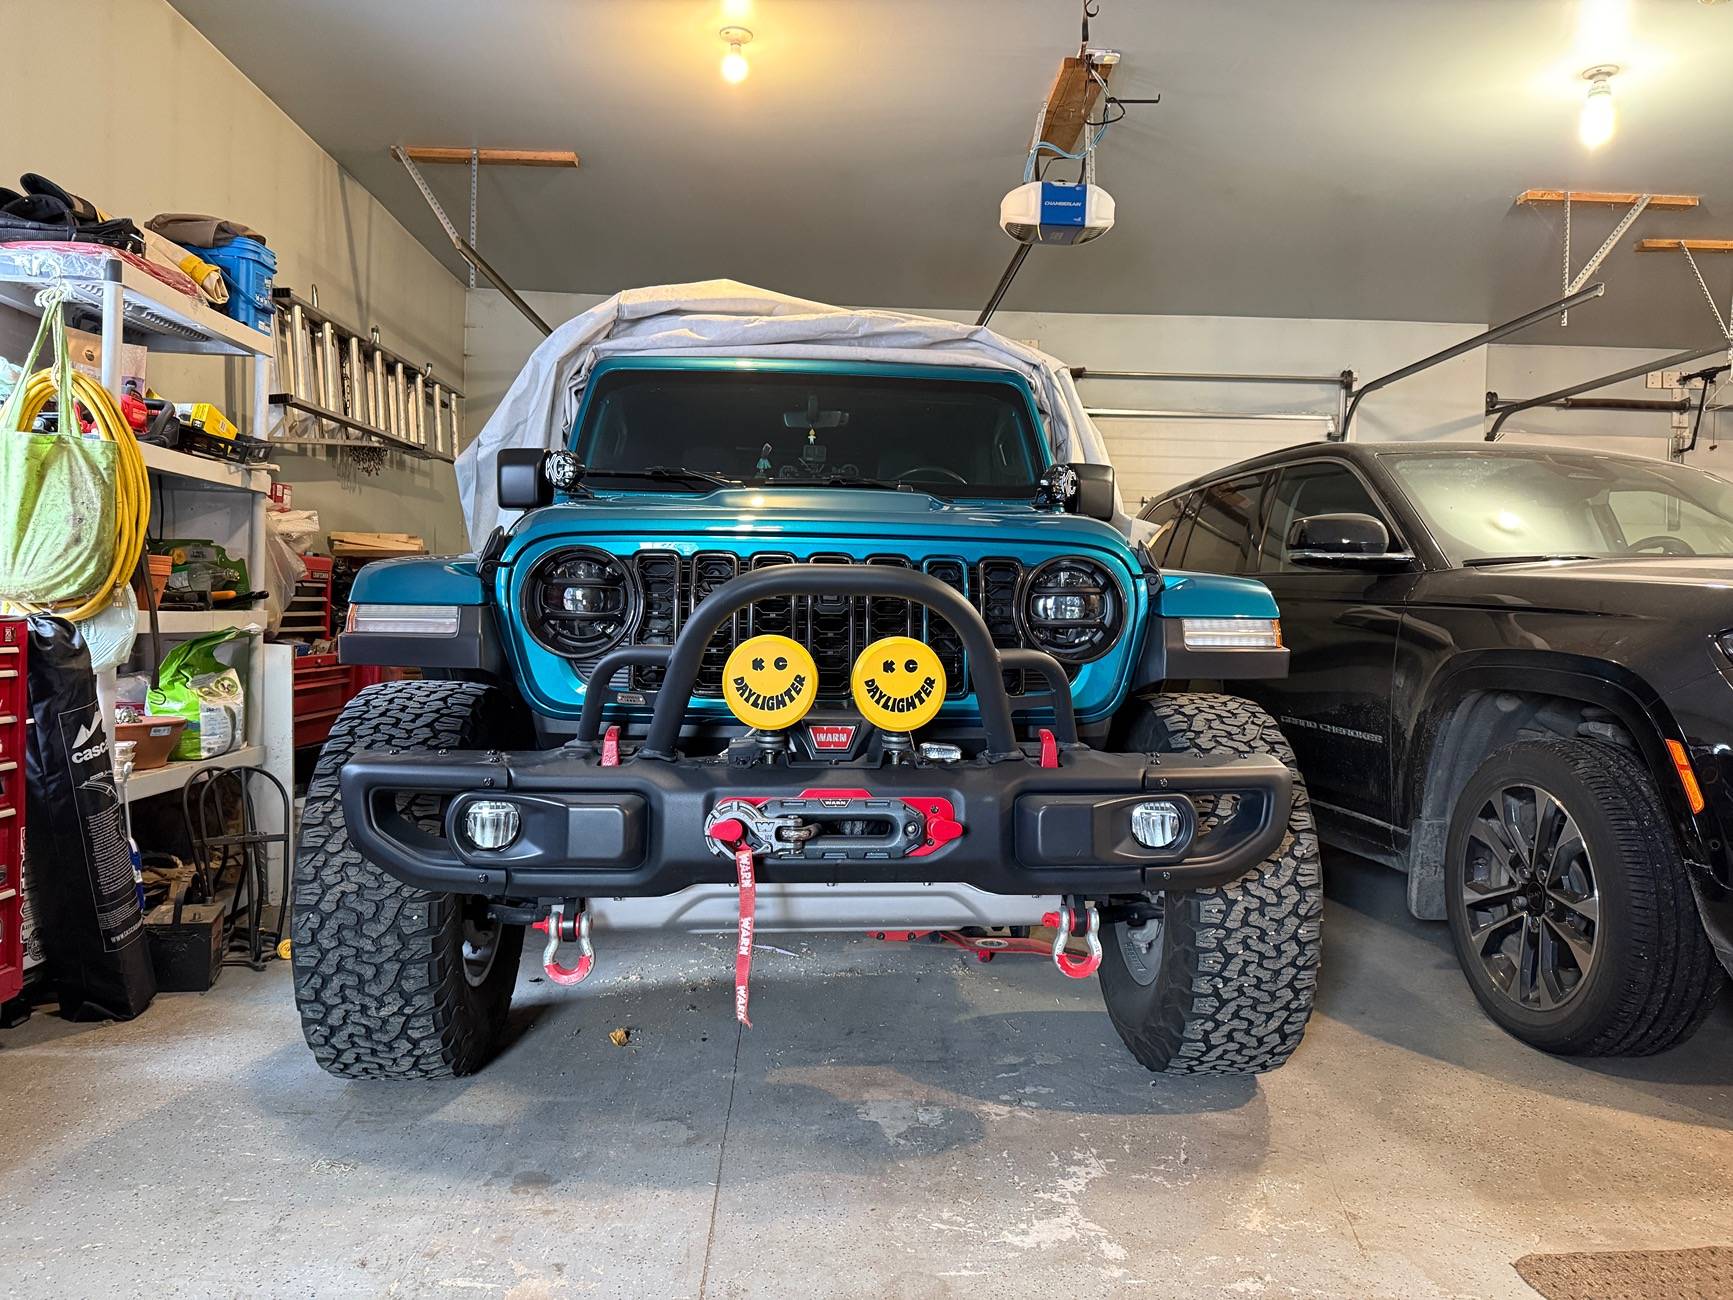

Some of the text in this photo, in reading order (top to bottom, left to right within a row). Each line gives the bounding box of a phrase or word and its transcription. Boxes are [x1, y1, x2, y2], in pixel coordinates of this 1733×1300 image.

[733, 674, 806, 711] DAYLIGHTER
[864, 676, 936, 713] DAYLIGHTER
[816, 733, 847, 742] WARN
[1280, 715, 1384, 743] GRAND CHEROKEE
[738, 853, 753, 888] WARN
[738, 916, 752, 956] WARN
